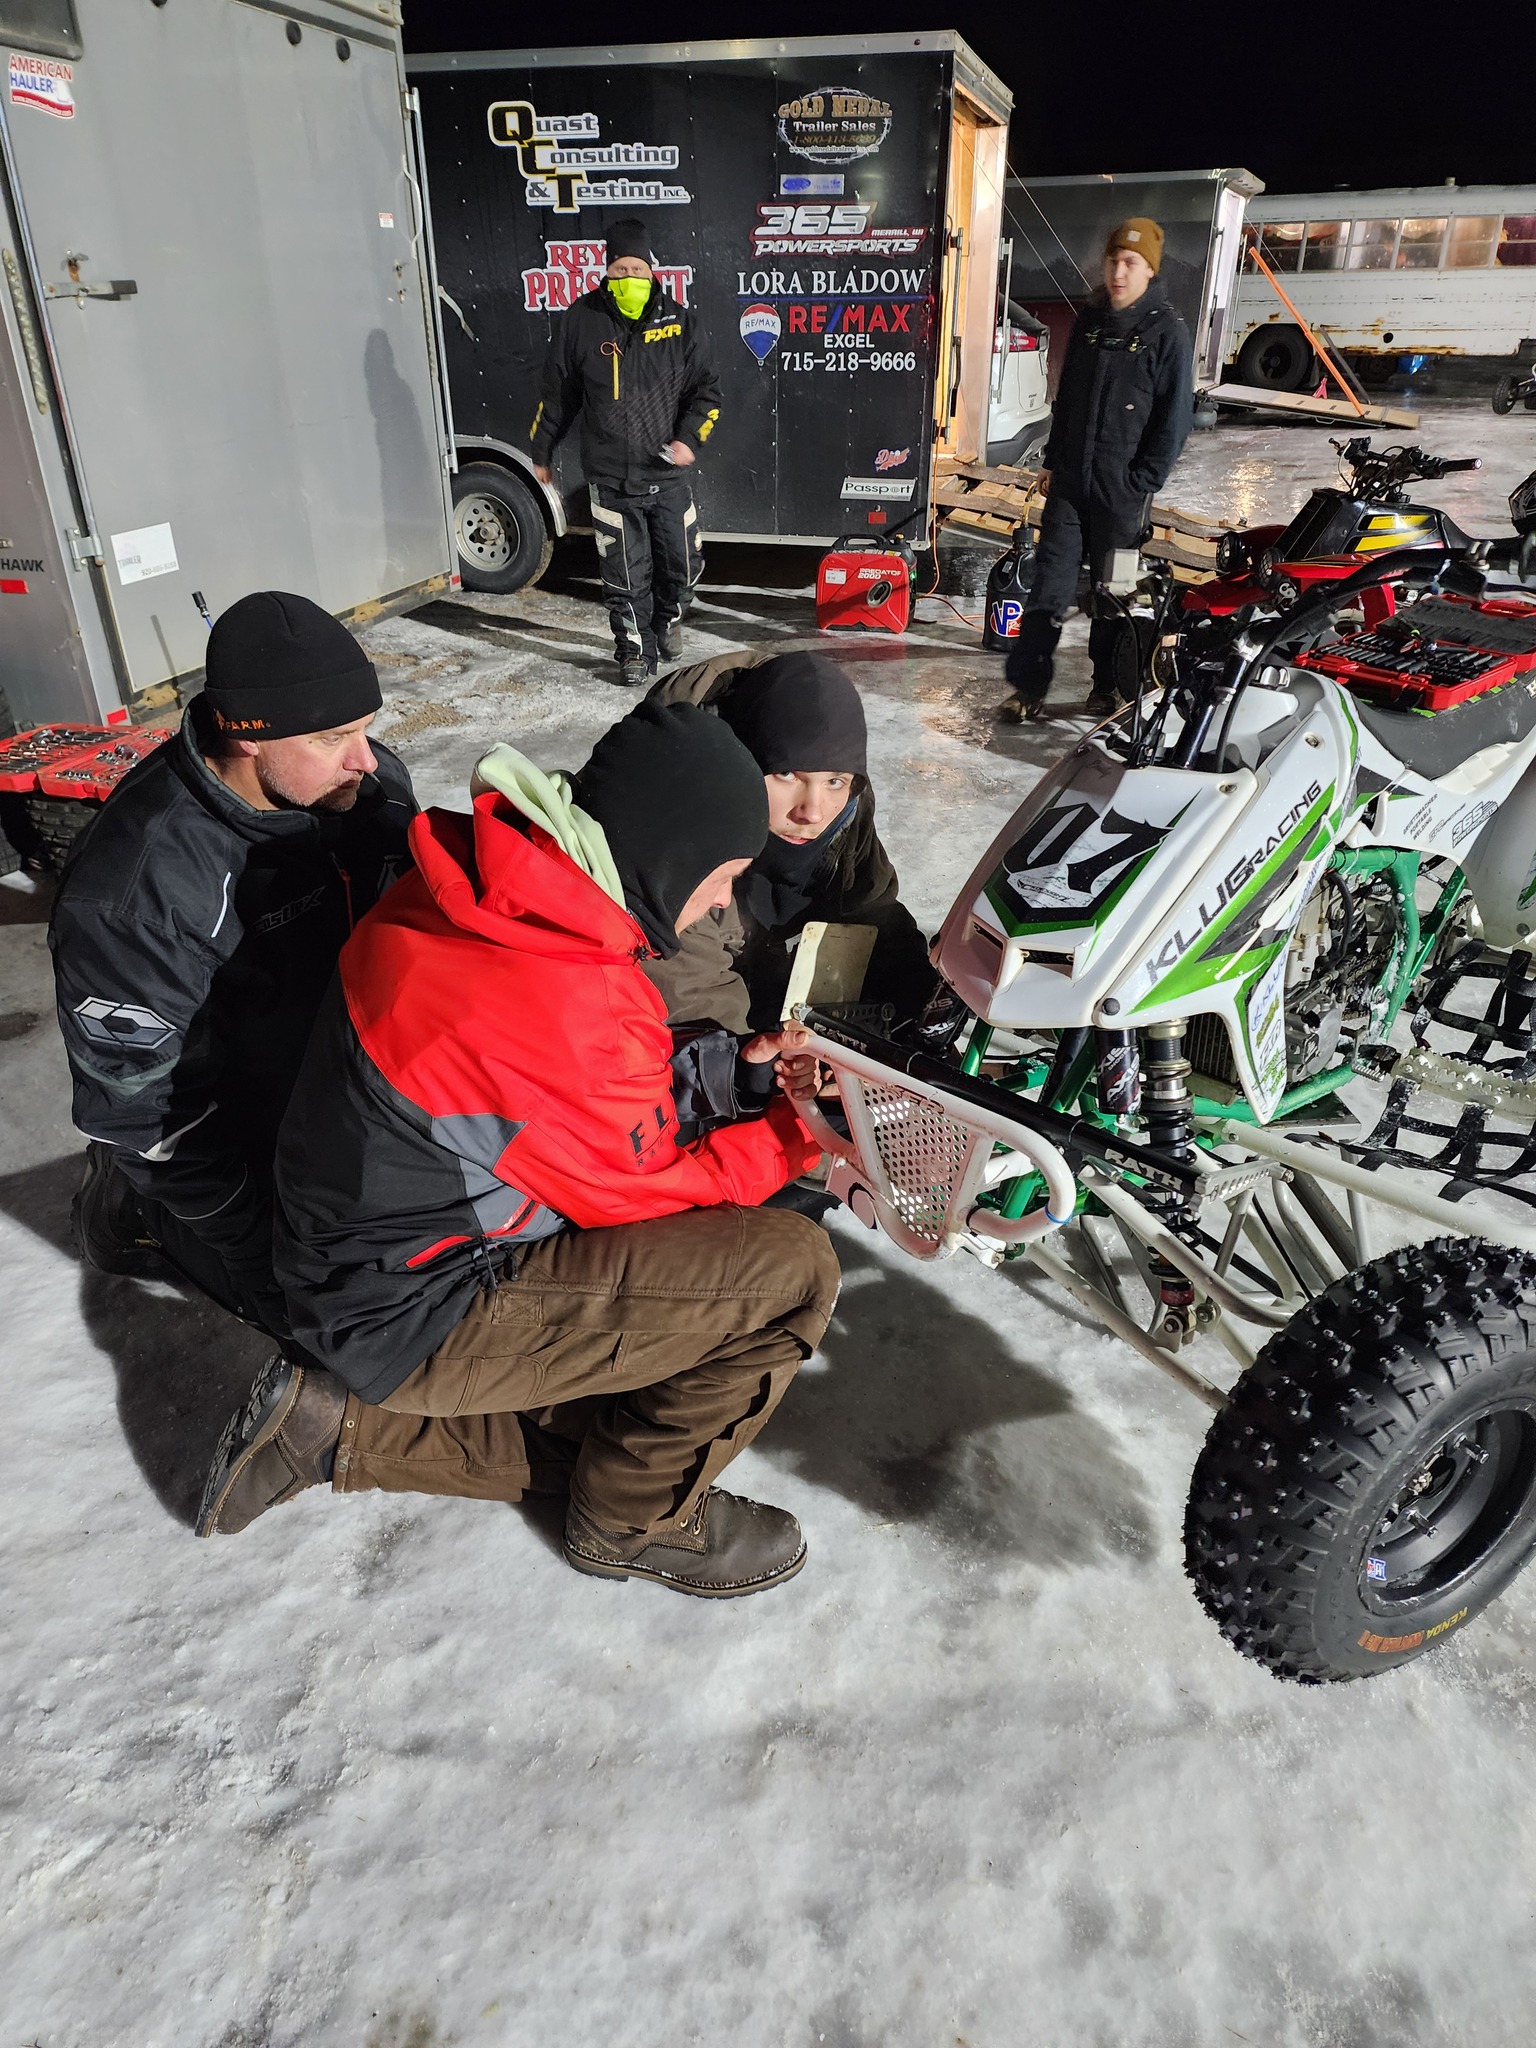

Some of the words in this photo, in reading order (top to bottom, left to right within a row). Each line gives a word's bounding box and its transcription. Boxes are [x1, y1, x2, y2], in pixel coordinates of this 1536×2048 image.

[9, 54, 73, 80] AMERICAN
[10, 72, 54, 93] HAULER
[778, 96, 824, 118] GOLD
[831, 95, 892, 117] MEDAL
[491, 106, 598, 147] Quast
[793, 121, 838, 132] Trailer
[841, 121, 877, 132] Sales
[520, 140, 677, 174] Consulting
[528, 181, 551, 198] &
[545, 173, 661, 208] Testing
[663, 190, 686, 198] INC.
[754, 205, 871, 236] 365
[754, 239, 920, 256] POWERSPORTS
[737, 271, 804, 295] LORA
[811, 269, 926, 294] BLADOW
[745, 318, 777, 329] RE/MAX
[789, 304, 911, 334] RE/MAX
[641, 324, 683, 344] FXR
[781, 351, 916, 372] 715-218-9666
[859, 567, 901, 576] PREDATOR
[992, 600, 1022, 637] VP
[1452, 800, 1484, 837] 365
[1106, 1053, 1140, 1103] AXIS
[1105, 1148, 1183, 1191] RATH
[1426, 1606, 1468, 1640] KENDA
